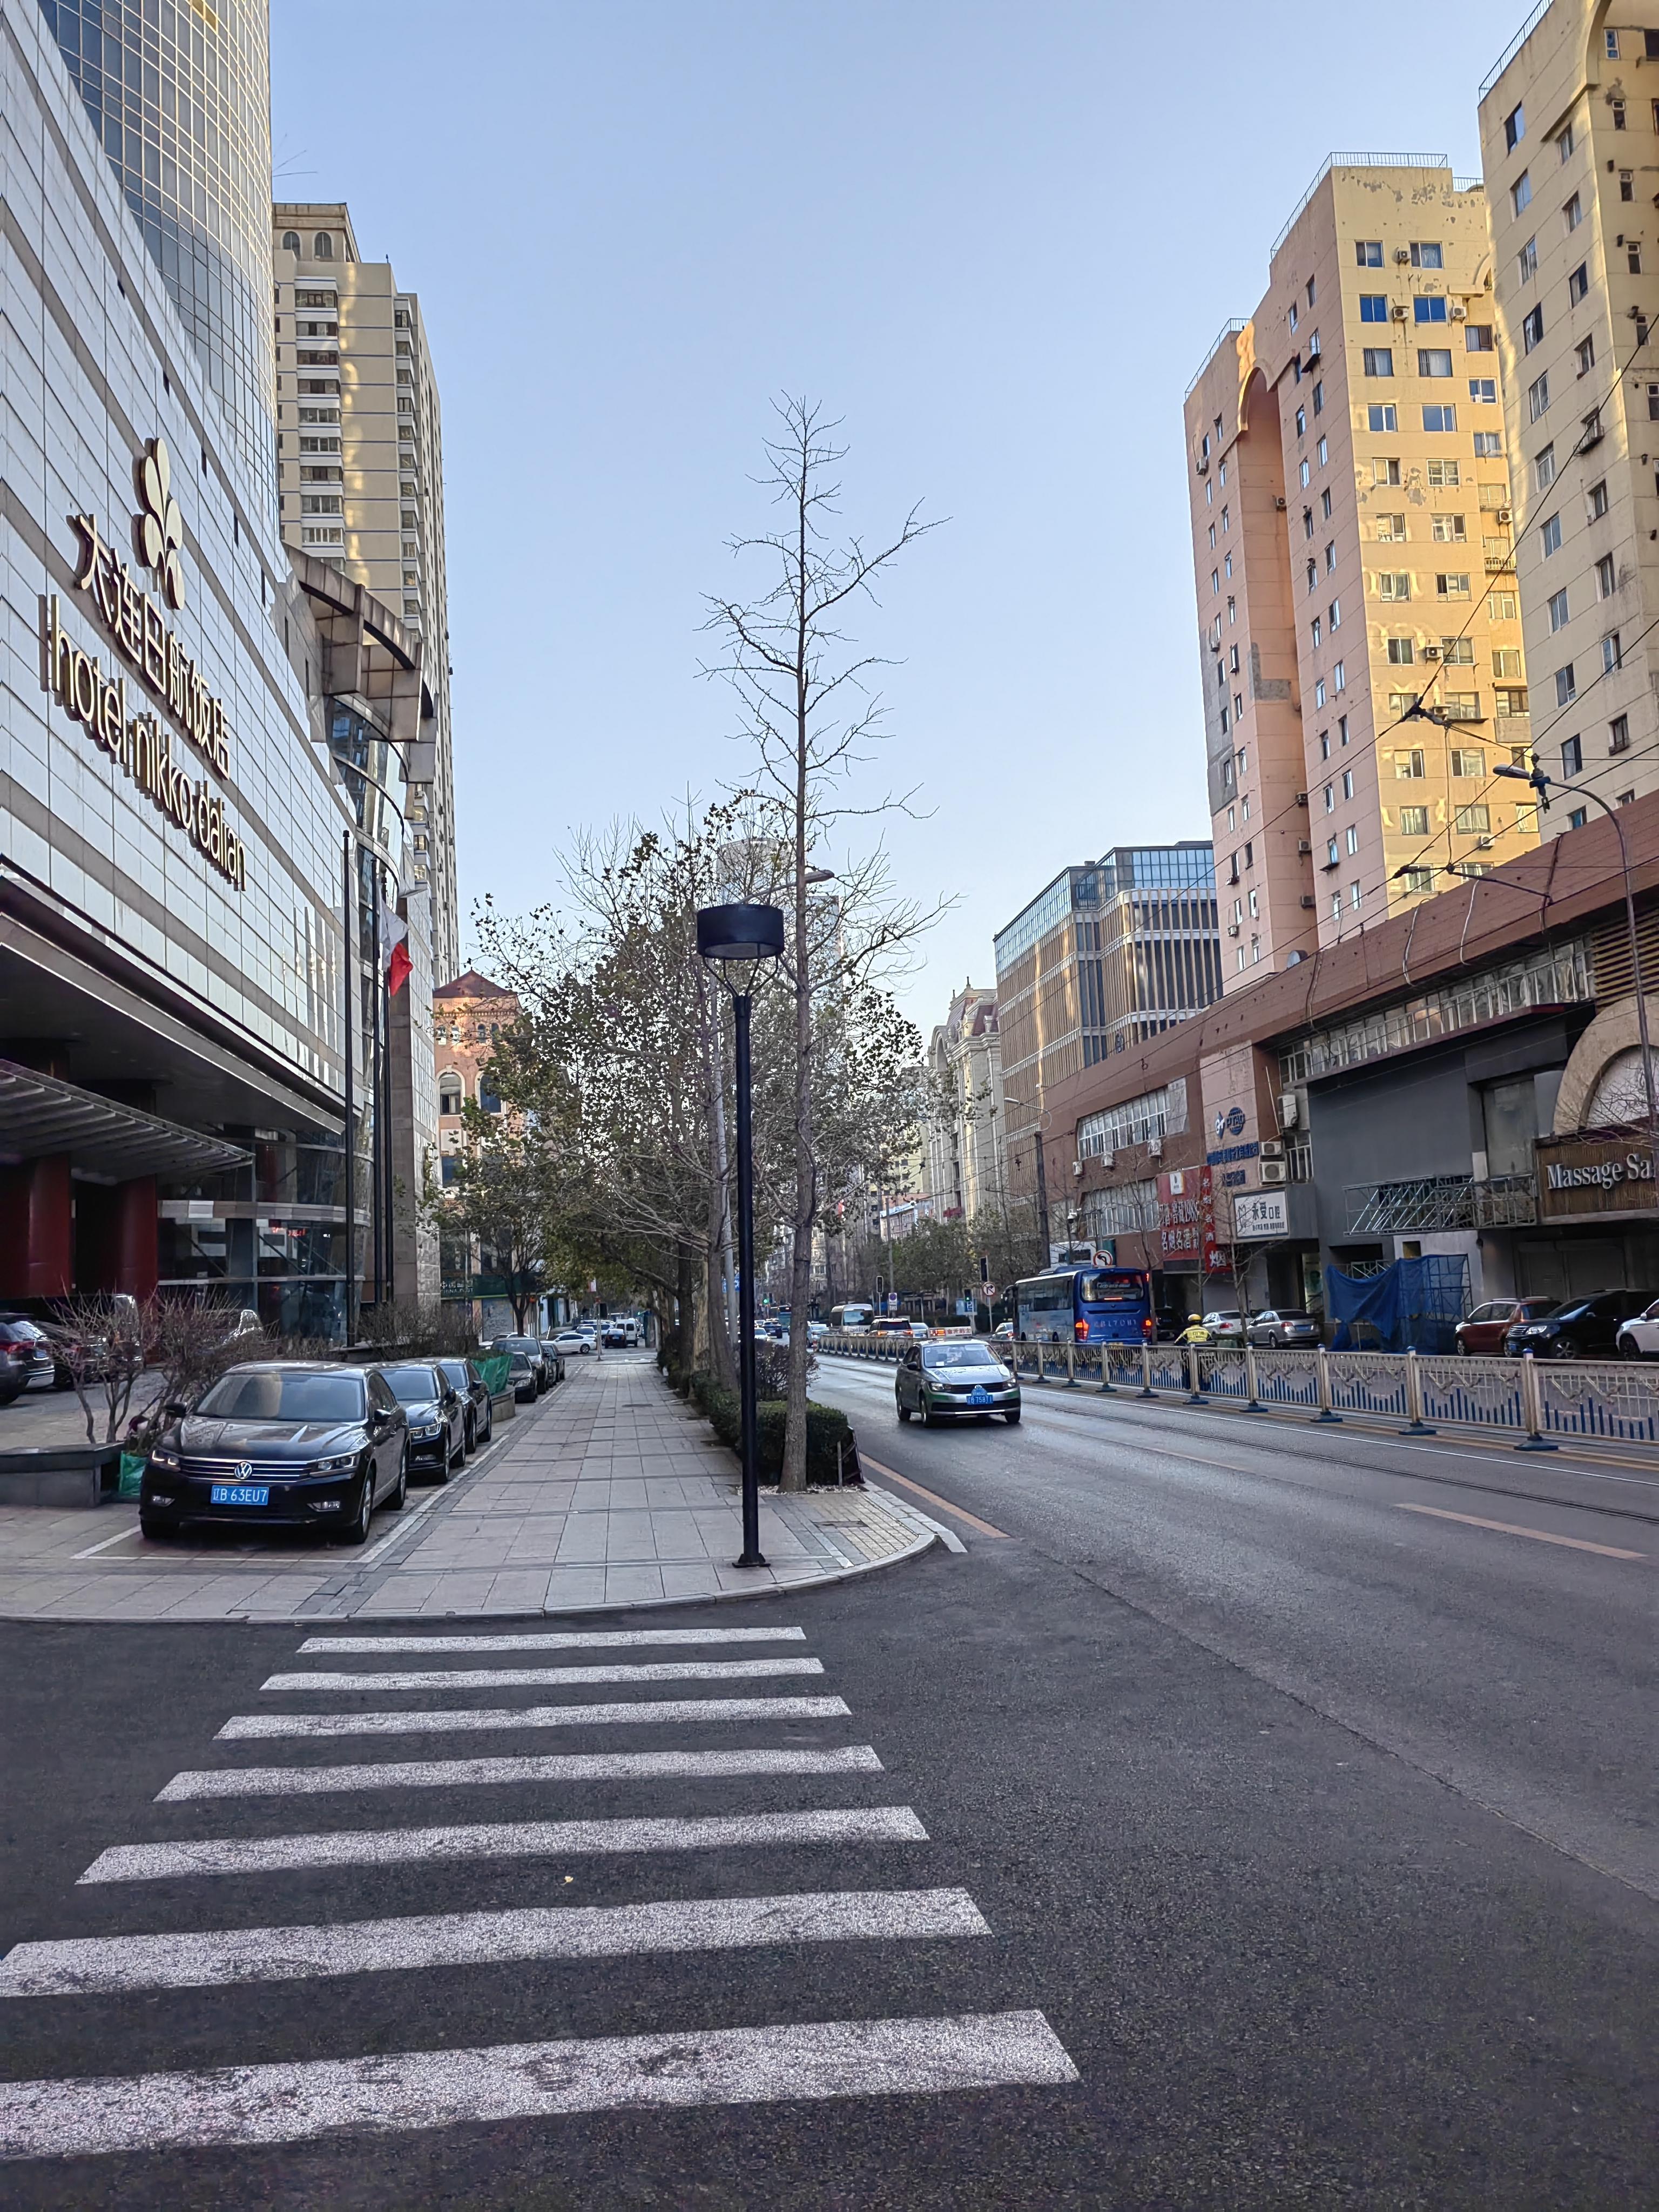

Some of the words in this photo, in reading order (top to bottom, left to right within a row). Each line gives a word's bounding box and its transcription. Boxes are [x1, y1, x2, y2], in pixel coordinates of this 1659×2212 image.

[51, 594, 127, 764] hotel
[133, 716, 193, 830] nikko
[198, 780, 246, 892] dalian
[75, 514, 230, 780] 大连日航饭店
[1546, 1162, 1624, 1189] Massage
